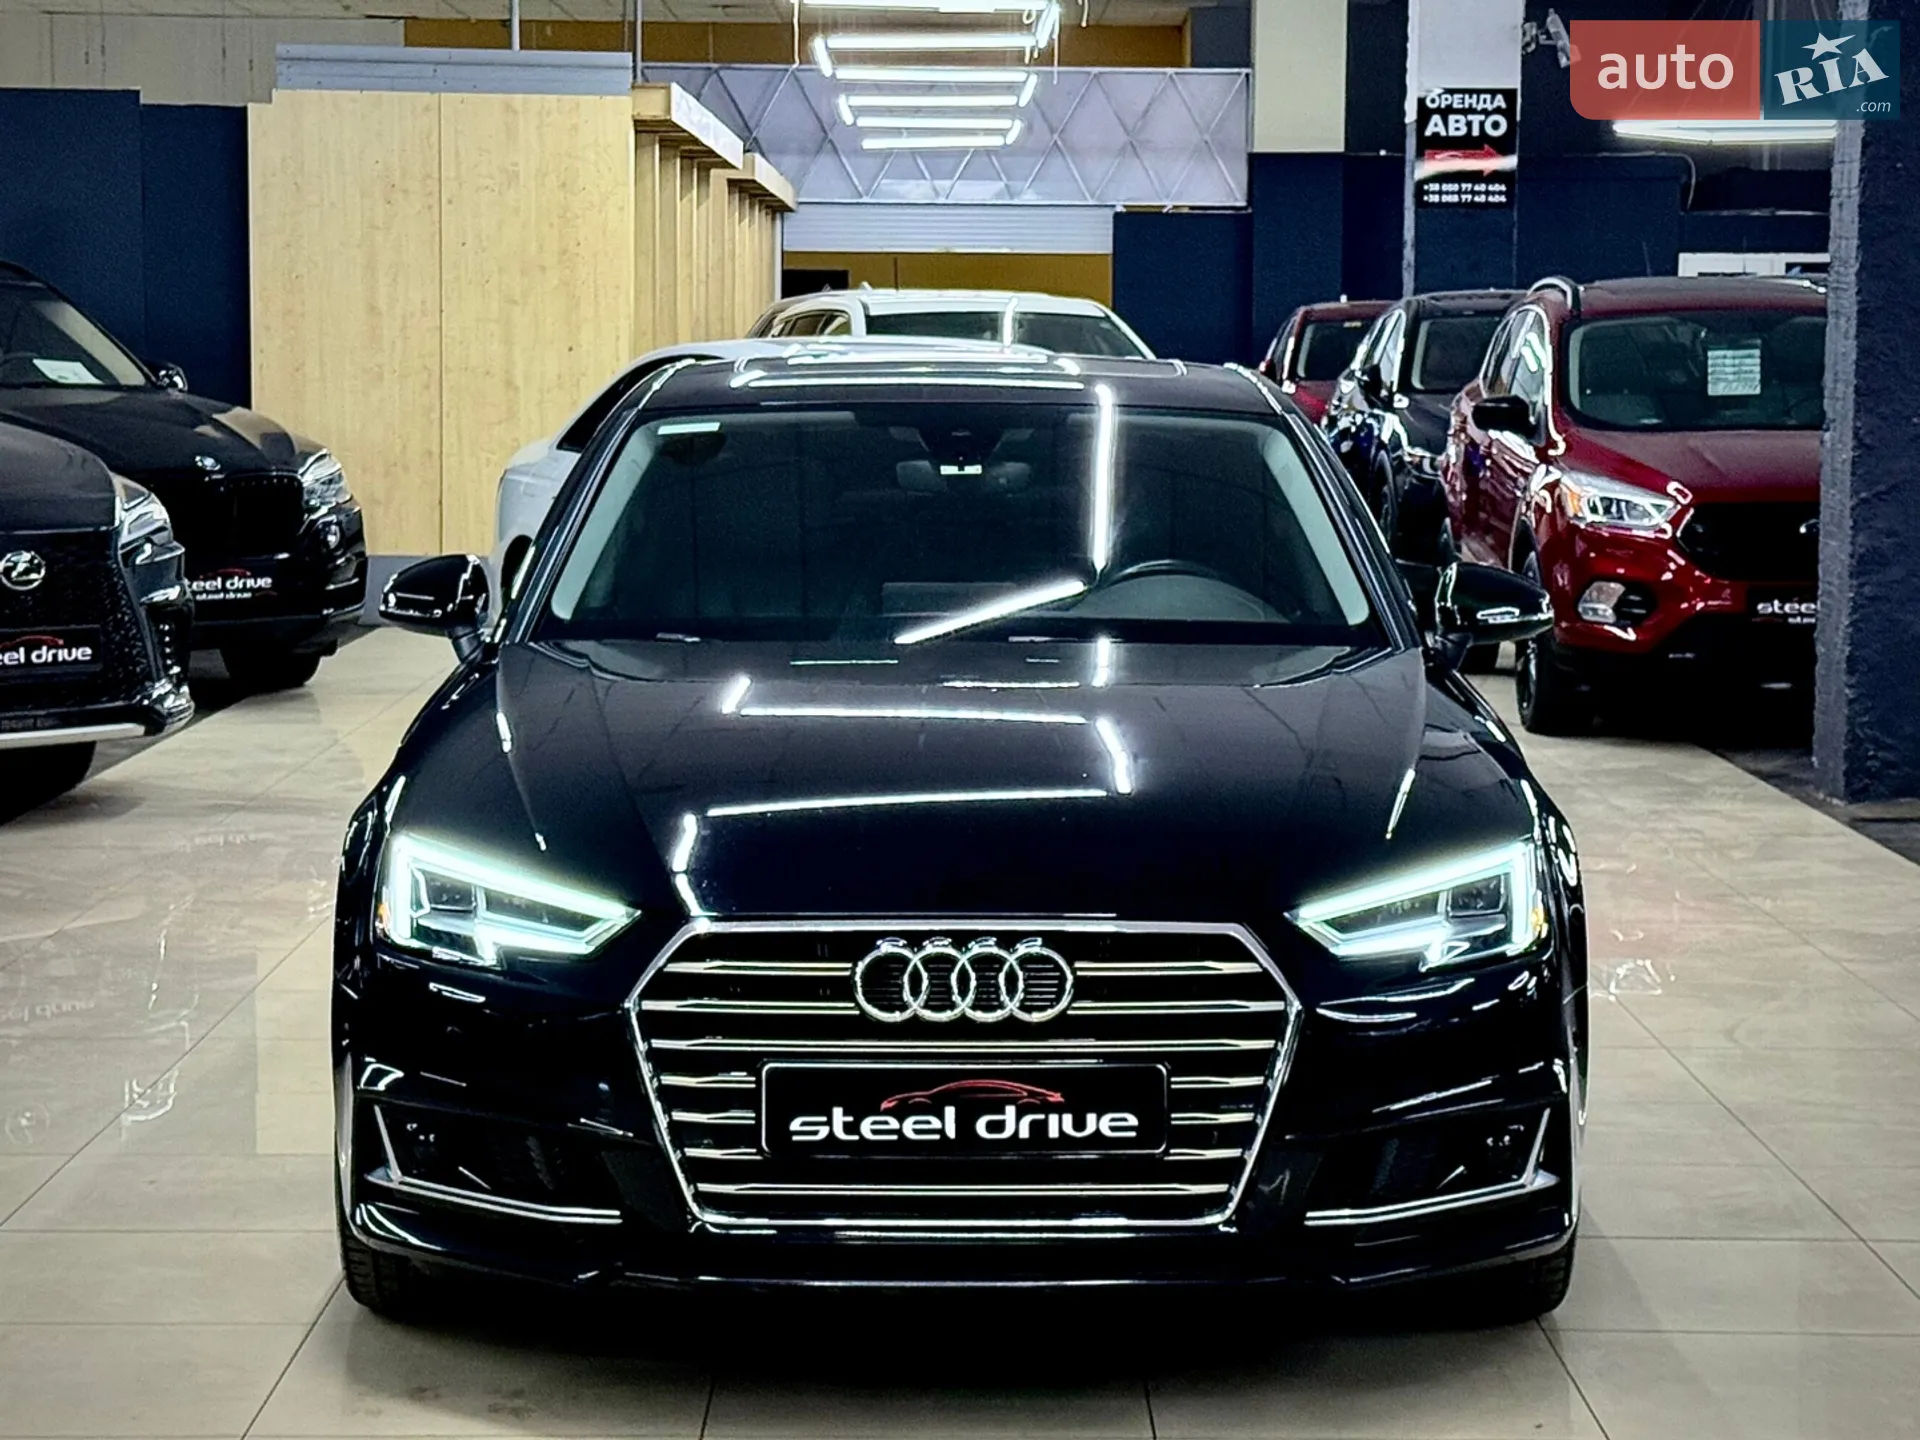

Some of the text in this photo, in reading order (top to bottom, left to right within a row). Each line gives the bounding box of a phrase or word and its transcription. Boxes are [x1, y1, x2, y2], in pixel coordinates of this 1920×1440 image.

[1425, 93, 1507, 111] ОРЕНДА
[1424, 114, 1508, 137] АВТО
[225, 576, 272, 590] drive
[31, 645, 93, 664] drive
[789, 1105, 1139, 1141] steel drive
